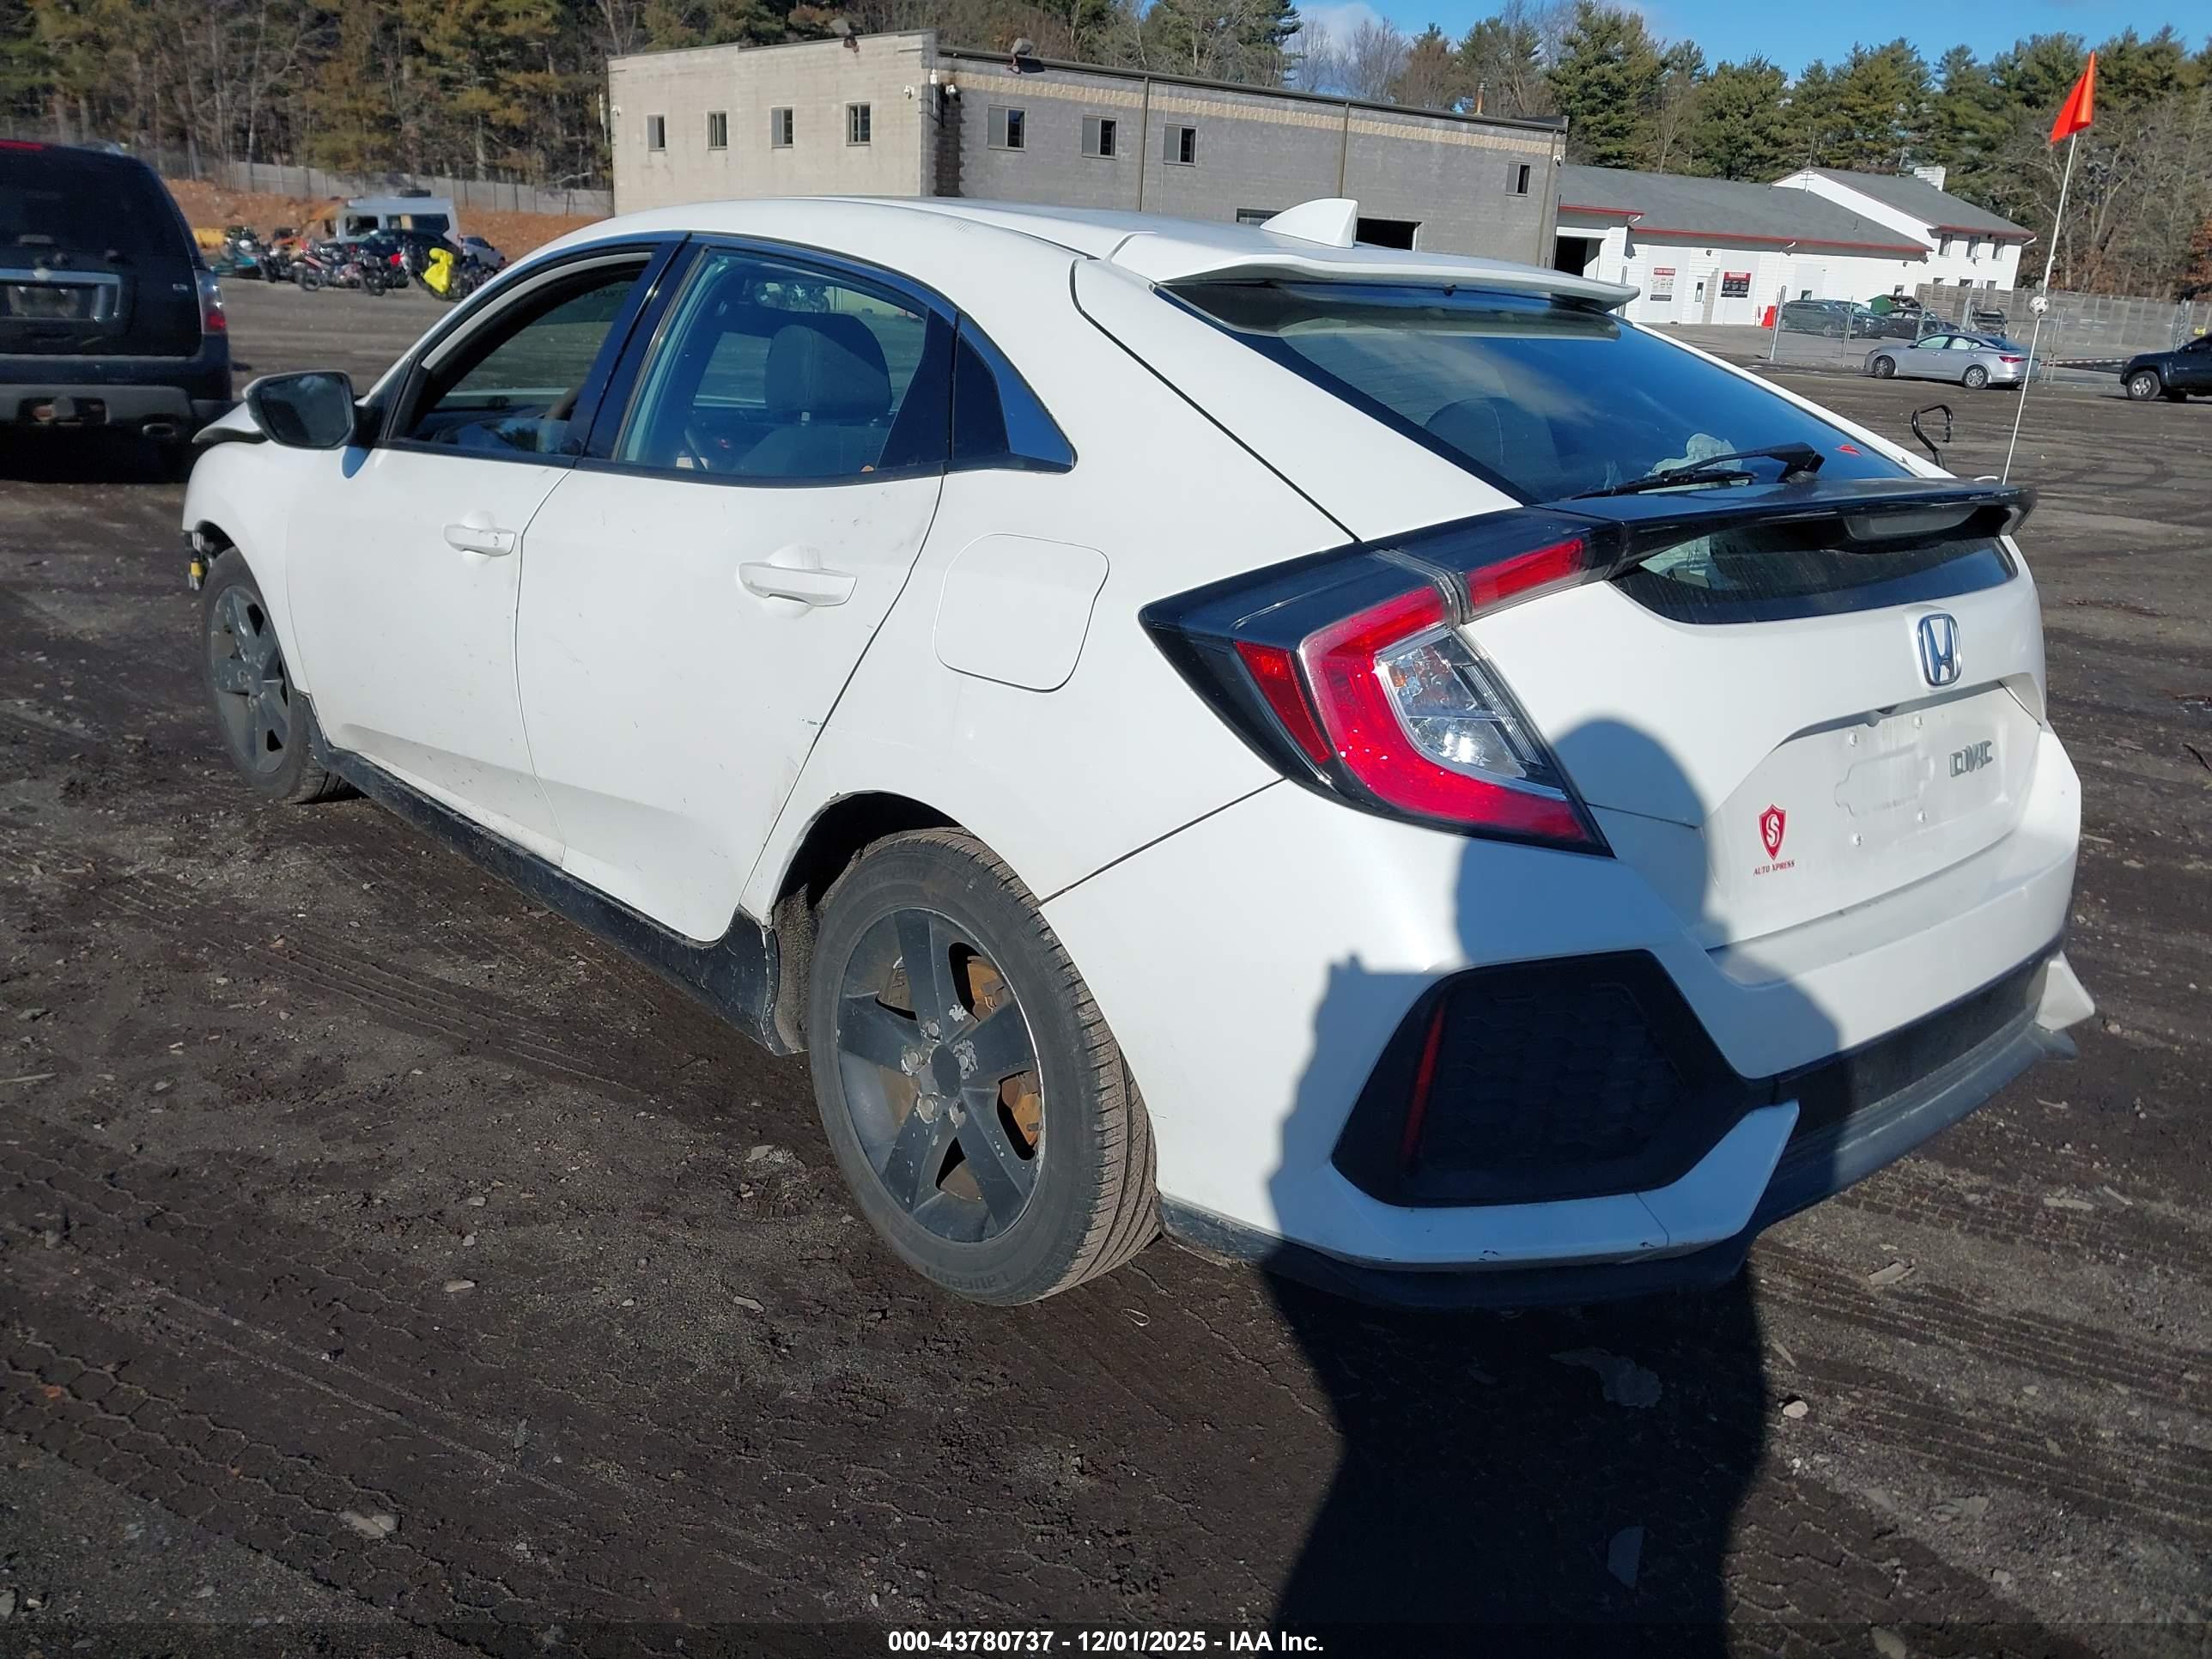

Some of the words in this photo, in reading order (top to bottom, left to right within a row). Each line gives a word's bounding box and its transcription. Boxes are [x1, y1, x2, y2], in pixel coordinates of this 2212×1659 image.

[1950, 740, 1993, 777] CIVIC
[1766, 813, 1780, 848] S
[1753, 866, 1770, 876] AUTO
[1771, 860, 1796, 872] XPRESS
